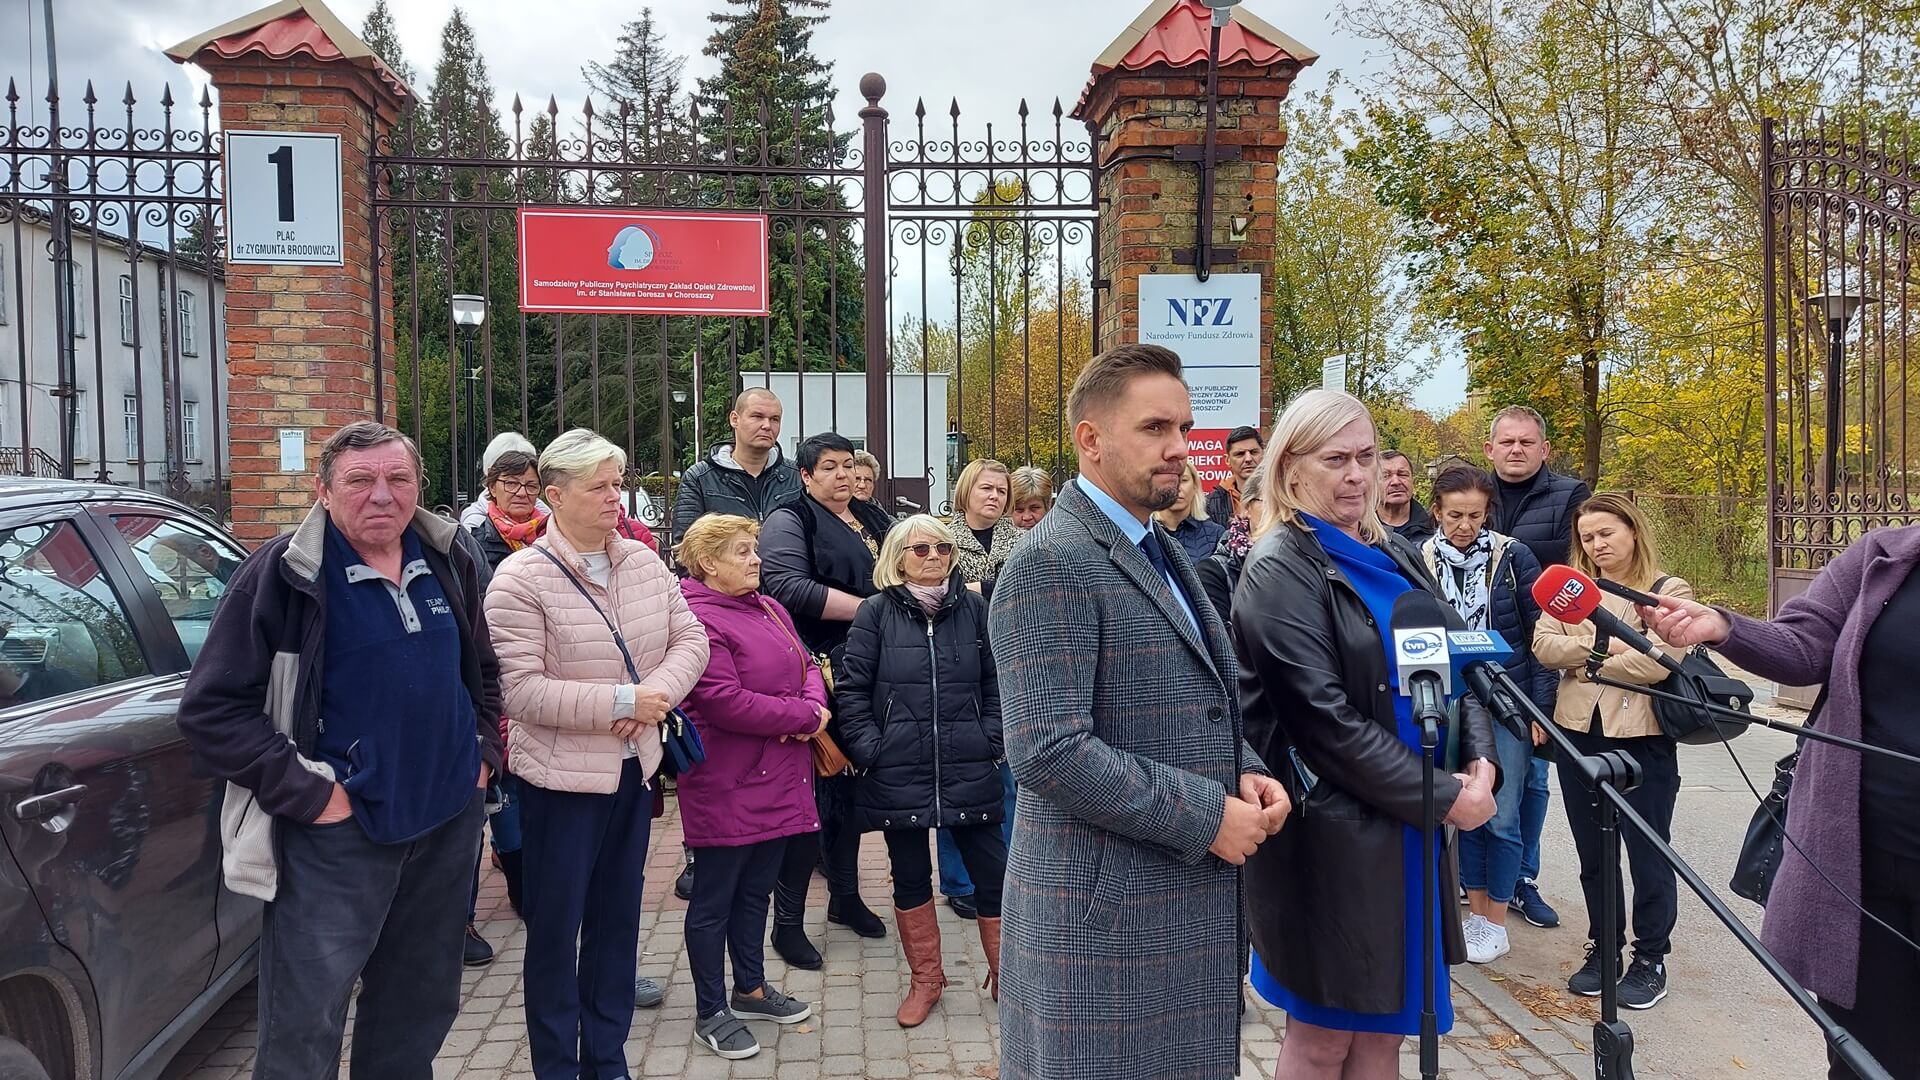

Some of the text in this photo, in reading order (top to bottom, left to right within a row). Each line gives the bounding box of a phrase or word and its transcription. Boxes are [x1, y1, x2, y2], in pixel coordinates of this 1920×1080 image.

[268, 145, 295, 222] 1
[276, 230, 296, 241] PLAC
[236, 244, 336, 256] dr ZYGMUNTA BRODOWICZA
[533, 279, 755, 293] Samodzielny Publiczny Psychiatryczny Zakład Opieki Zdrowotnej
[589, 289, 597, 297] dr
[598, 289, 636, 298] Stanisława
[637, 290, 665, 298] Deresza
[674, 291, 715, 300] Choroszczy
[1166, 298, 1233, 326] NFZ
[1146, 332, 1185, 341] Narodowy
[1222, 331, 1254, 339] Zdrowia
[1187, 440, 1223, 451] WAGA
[1188, 455, 1222, 466] BIEKT
[1197, 470, 1233, 481] ROWA
[1549, 580, 1582, 611] TOK FM
